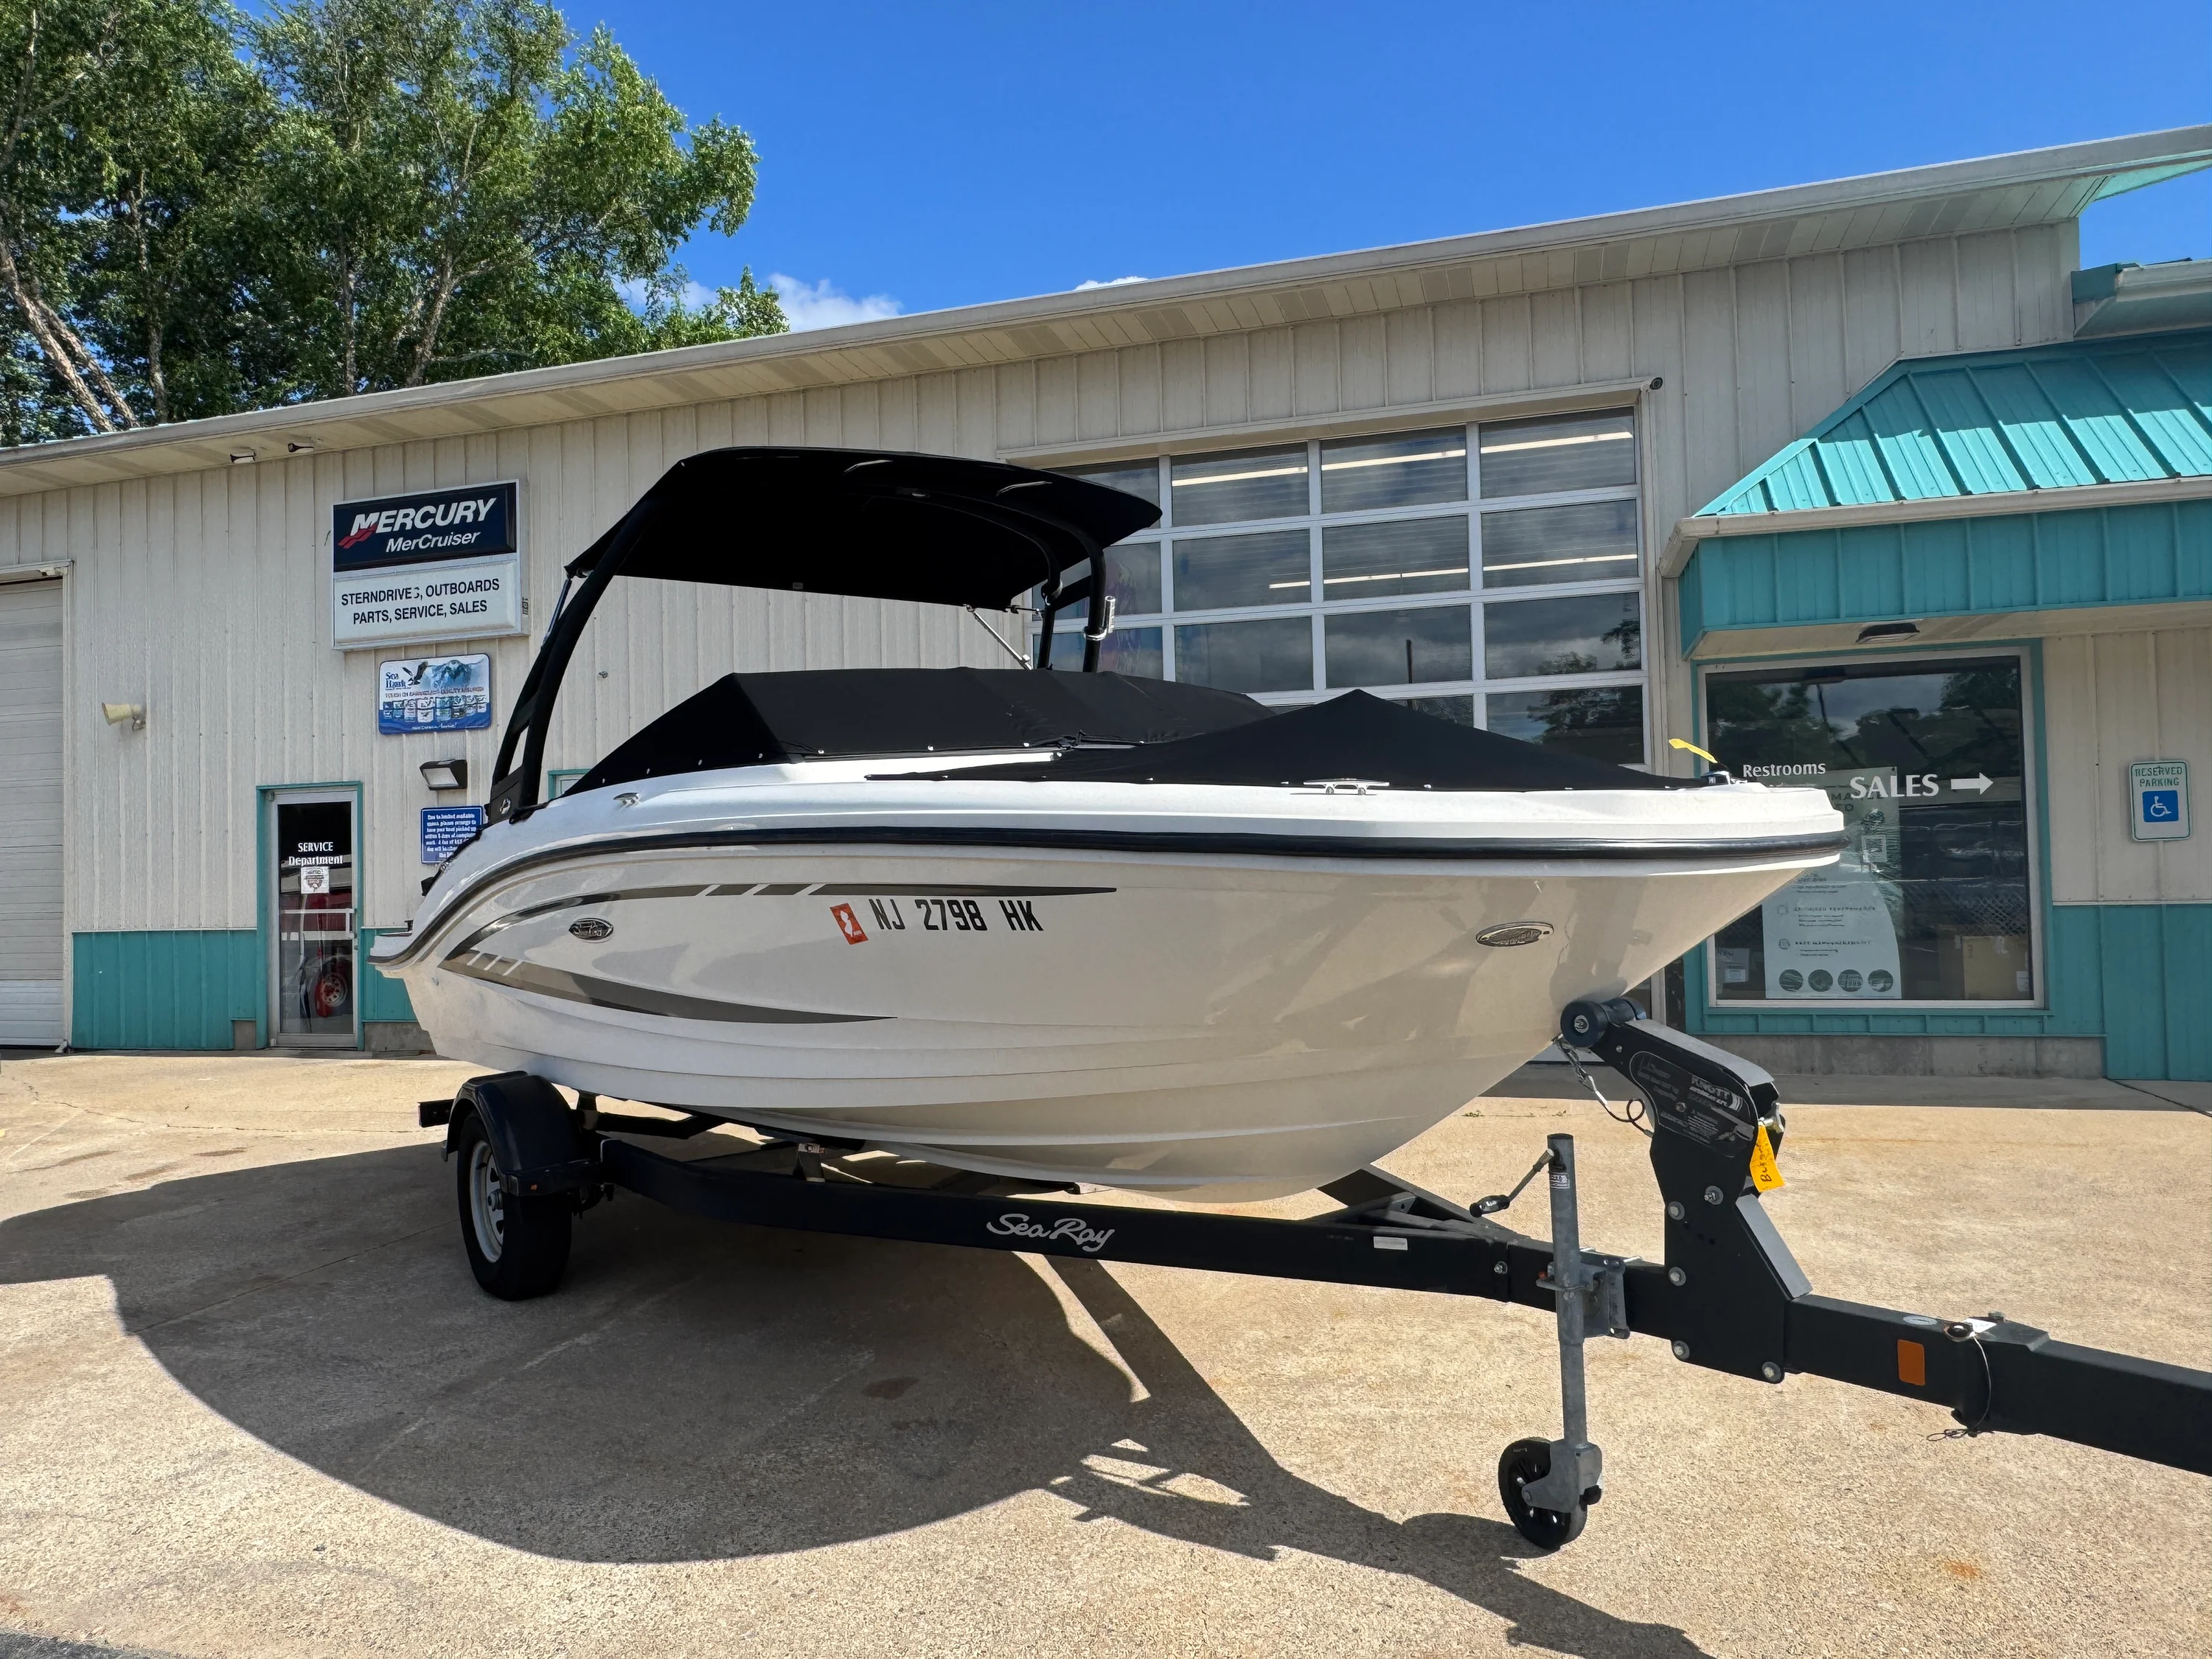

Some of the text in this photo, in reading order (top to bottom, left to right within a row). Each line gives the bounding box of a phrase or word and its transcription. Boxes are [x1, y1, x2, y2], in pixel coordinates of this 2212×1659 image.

[350, 498, 497, 536] MERCURY
[386, 531, 481, 552] MerCruiser
[425, 578, 500, 597] OUTBOARDS
[353, 600, 487, 625] PARTS, SERVICE, SALES
[1742, 762, 1826, 778] Restrooms
[2135, 766, 2183, 776] RESERVED
[1849, 773, 1940, 799] SALES
[2140, 777, 2180, 787] PARKING
[298, 841, 333, 853] SERVICE
[288, 855, 344, 867] Department
[869, 899, 1044, 931] NJ 2798 HK
[986, 1213, 1115, 1252] Sea Ray
